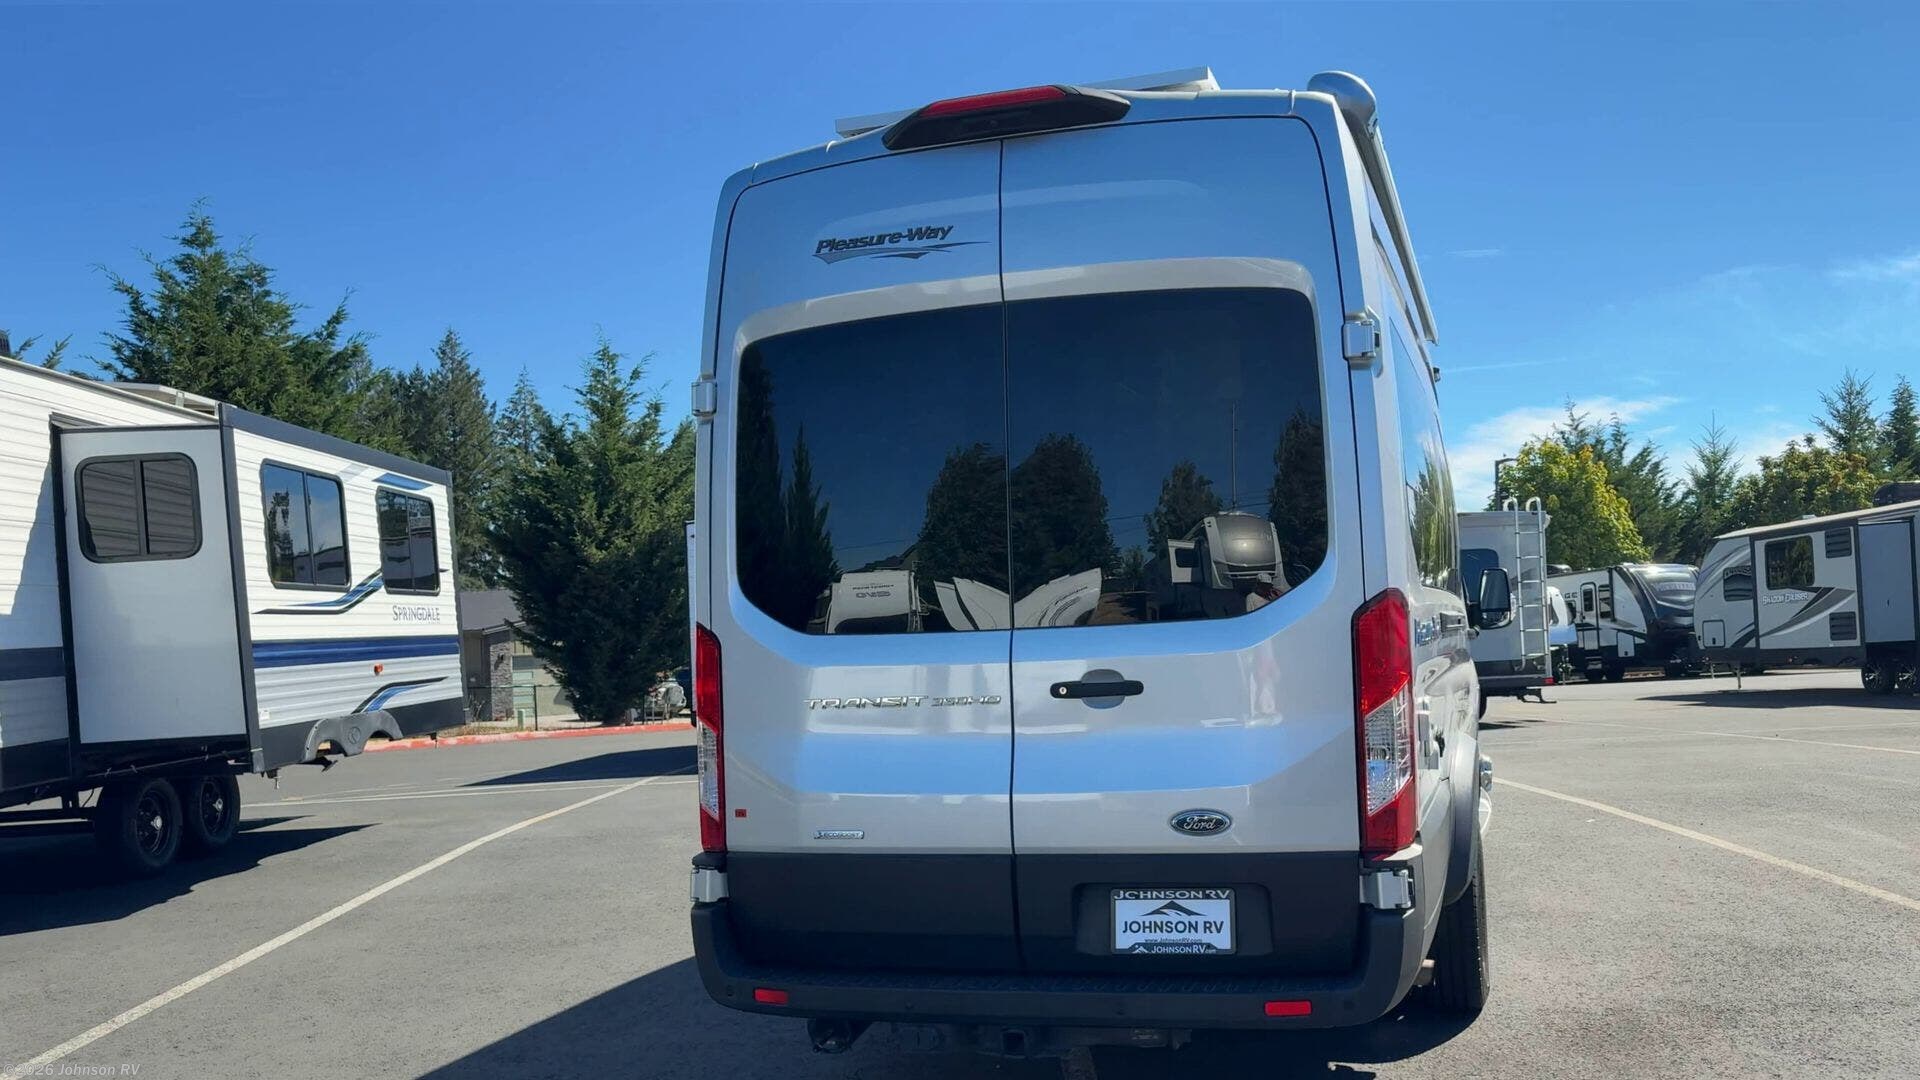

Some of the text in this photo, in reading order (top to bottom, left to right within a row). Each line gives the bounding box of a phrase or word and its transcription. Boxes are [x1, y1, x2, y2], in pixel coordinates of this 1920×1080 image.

[815, 225, 954, 253] Pleasure-Way
[392, 605, 440, 621] SPRINGDALE
[804, 695, 929, 710] TRANSIT
[1184, 815, 1217, 829] Ford
[1205, 889, 1230, 899] RV
[1122, 920, 1225, 934] JOHNSON RV
